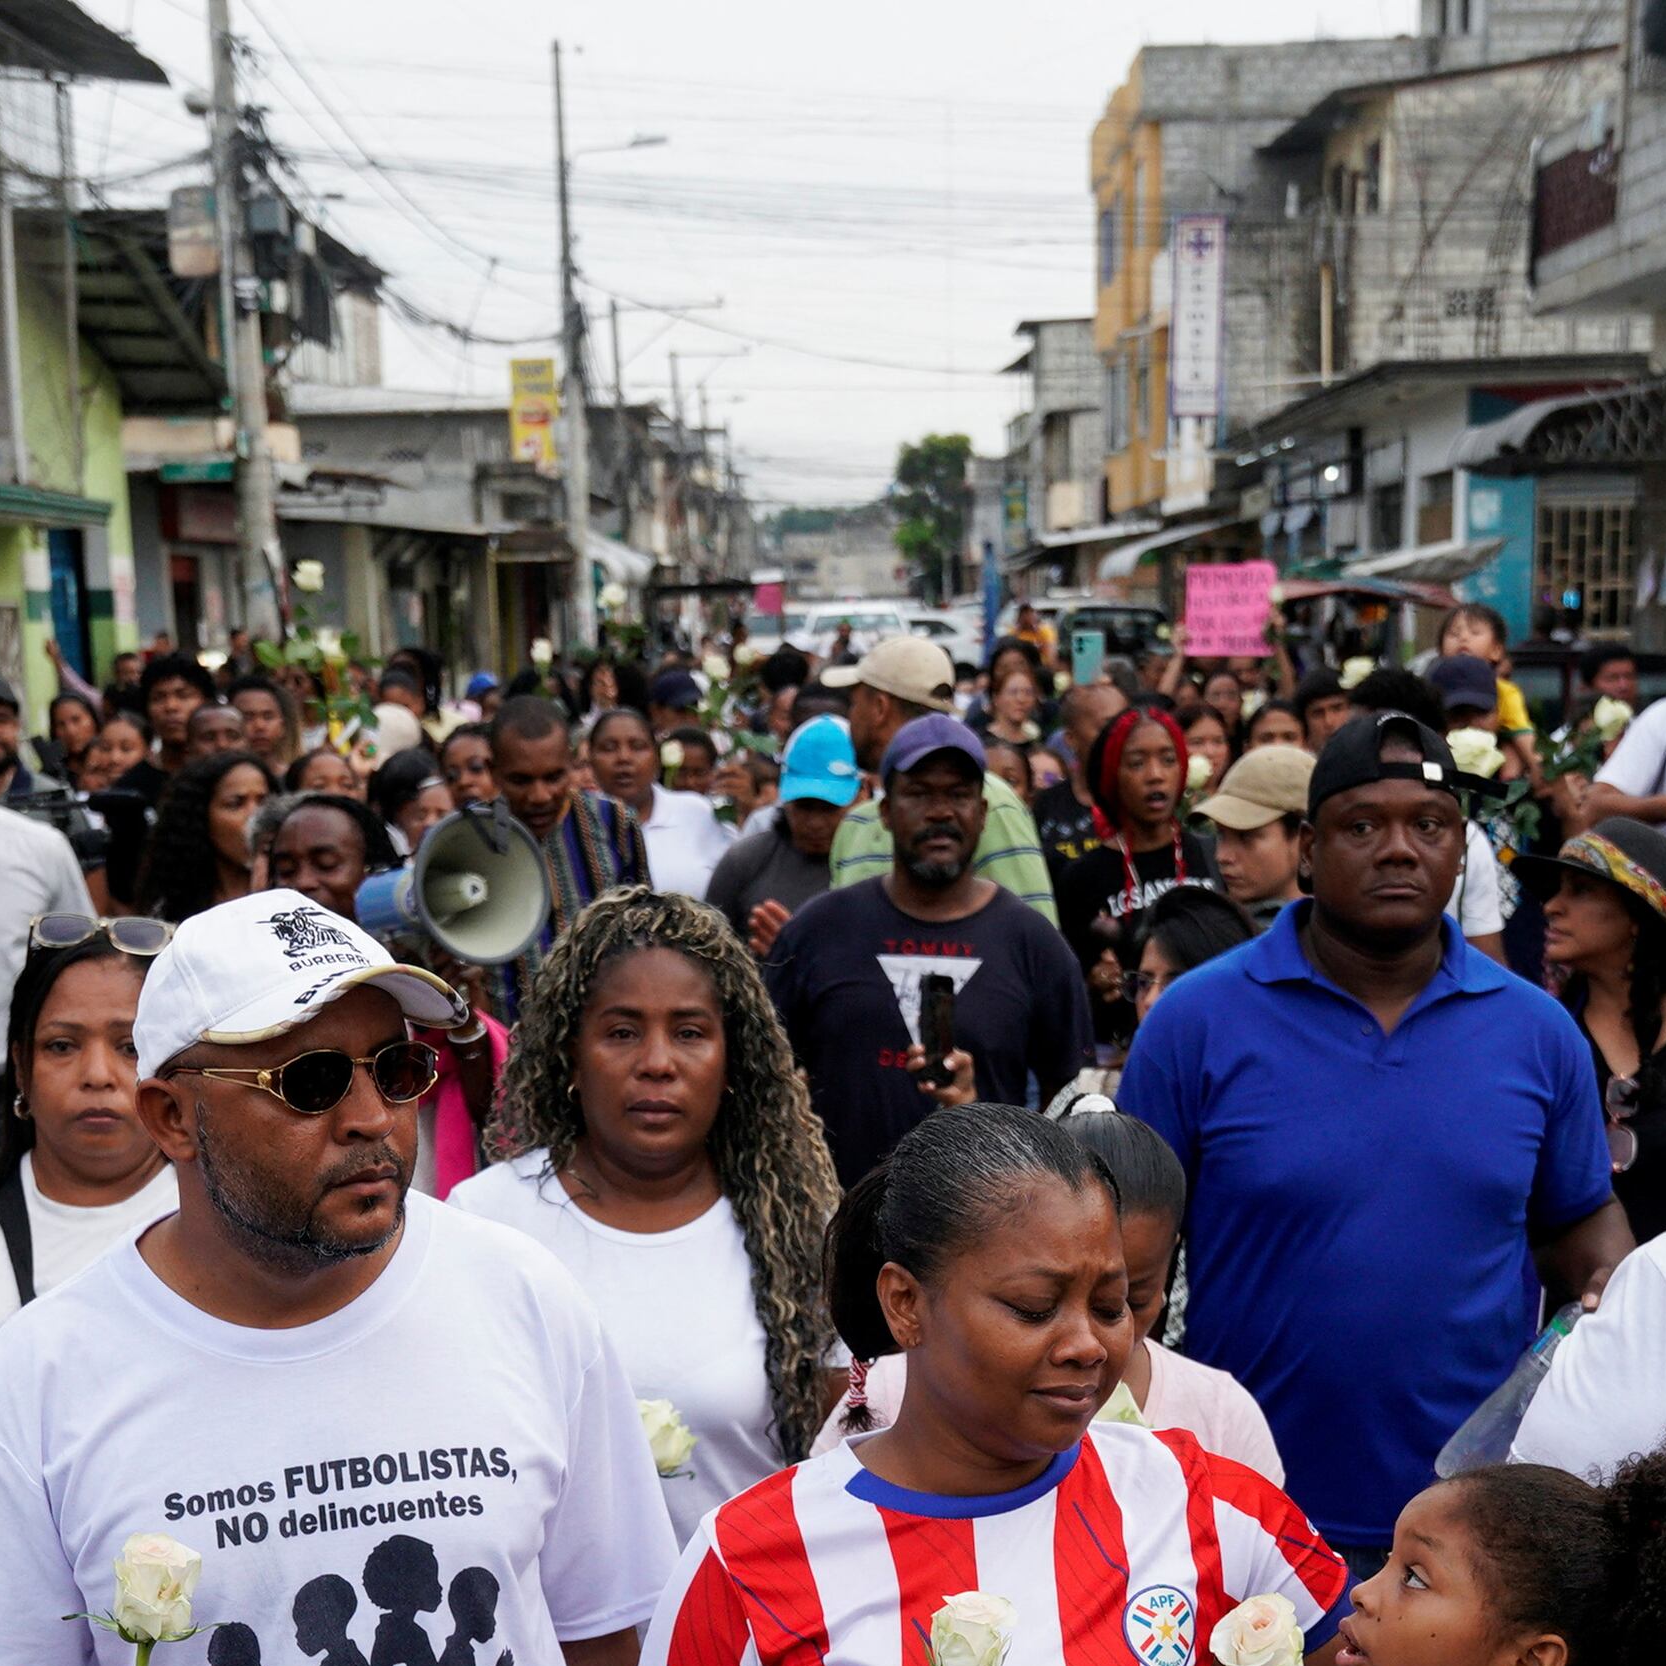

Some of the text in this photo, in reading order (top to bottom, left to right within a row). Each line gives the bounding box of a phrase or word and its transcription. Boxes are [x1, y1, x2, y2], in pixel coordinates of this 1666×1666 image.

[883, 938, 975, 957] TOMMY
[164, 1447, 518, 1521] Somos FUTBOLISTAS,
[215, 1490, 485, 1549] NO delincuentes
[1150, 1594, 1175, 1609] APF
